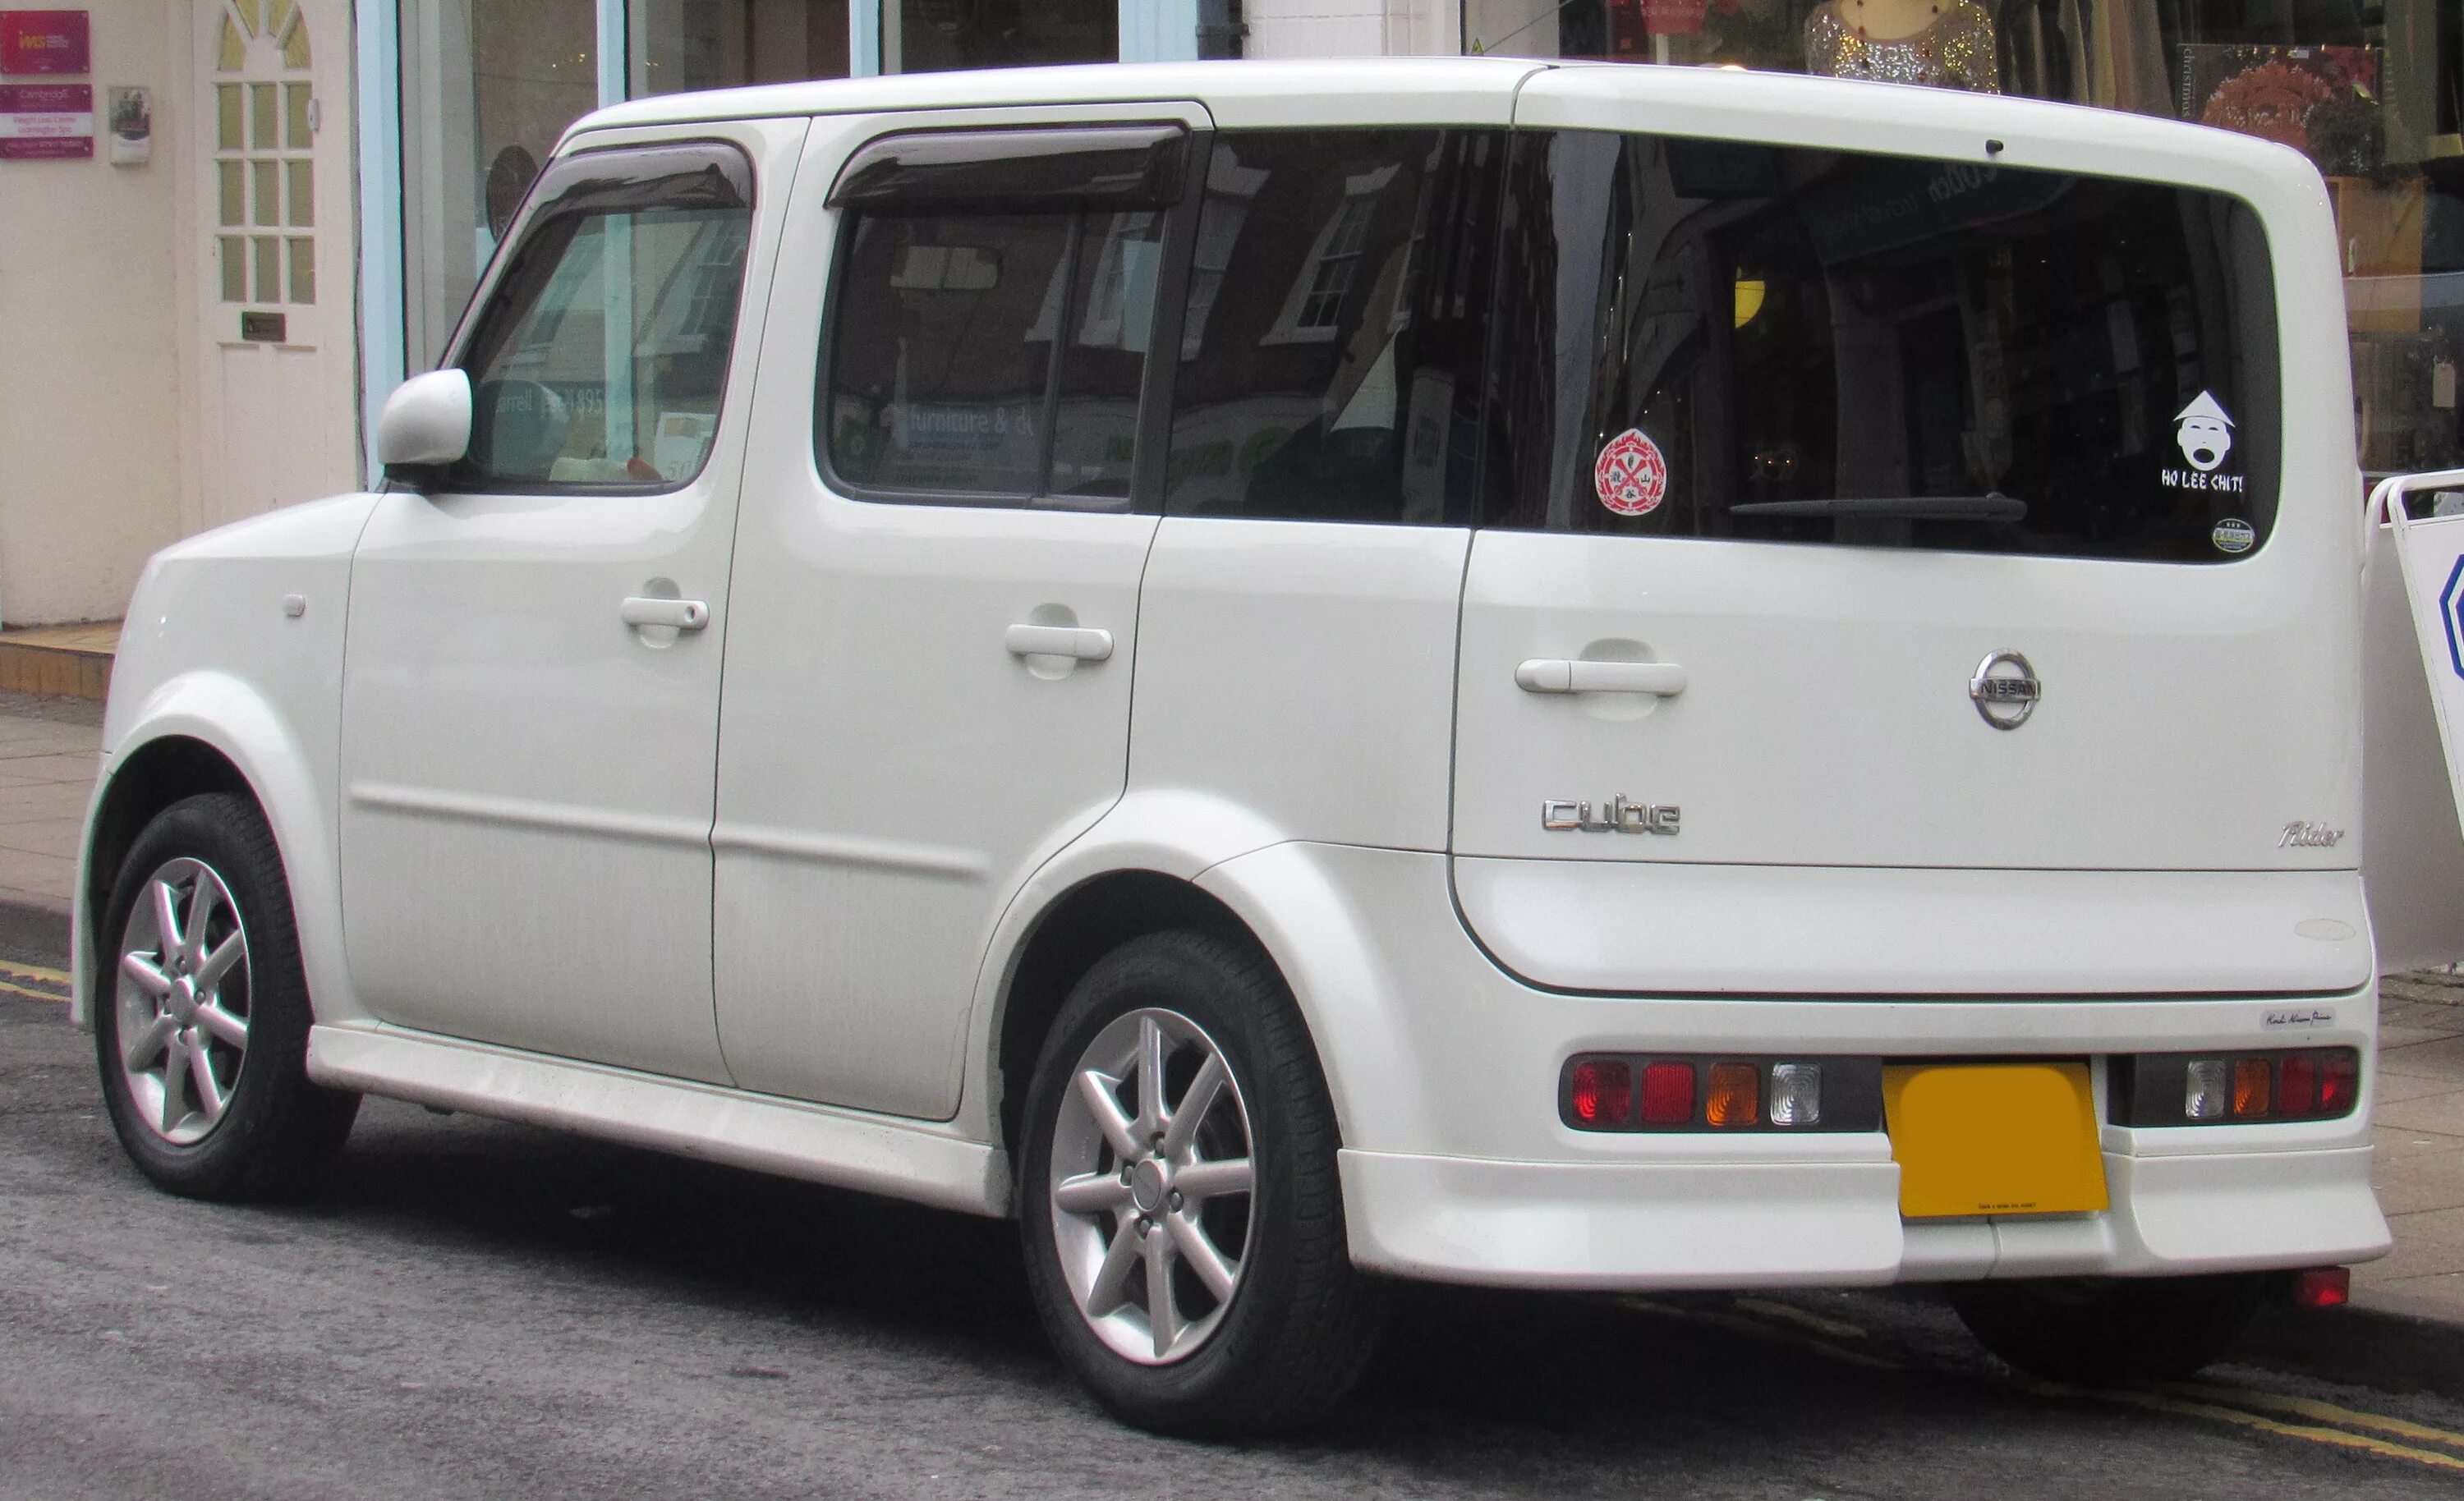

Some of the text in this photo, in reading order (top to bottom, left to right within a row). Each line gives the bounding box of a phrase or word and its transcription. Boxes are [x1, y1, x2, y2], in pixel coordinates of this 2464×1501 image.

[2162, 469, 2243, 493] HO LEE CHIT!
[1980, 681, 2036, 696] NISSAN
[1542, 792, 1680, 836] cube
[2278, 821, 2344, 847] Rider
